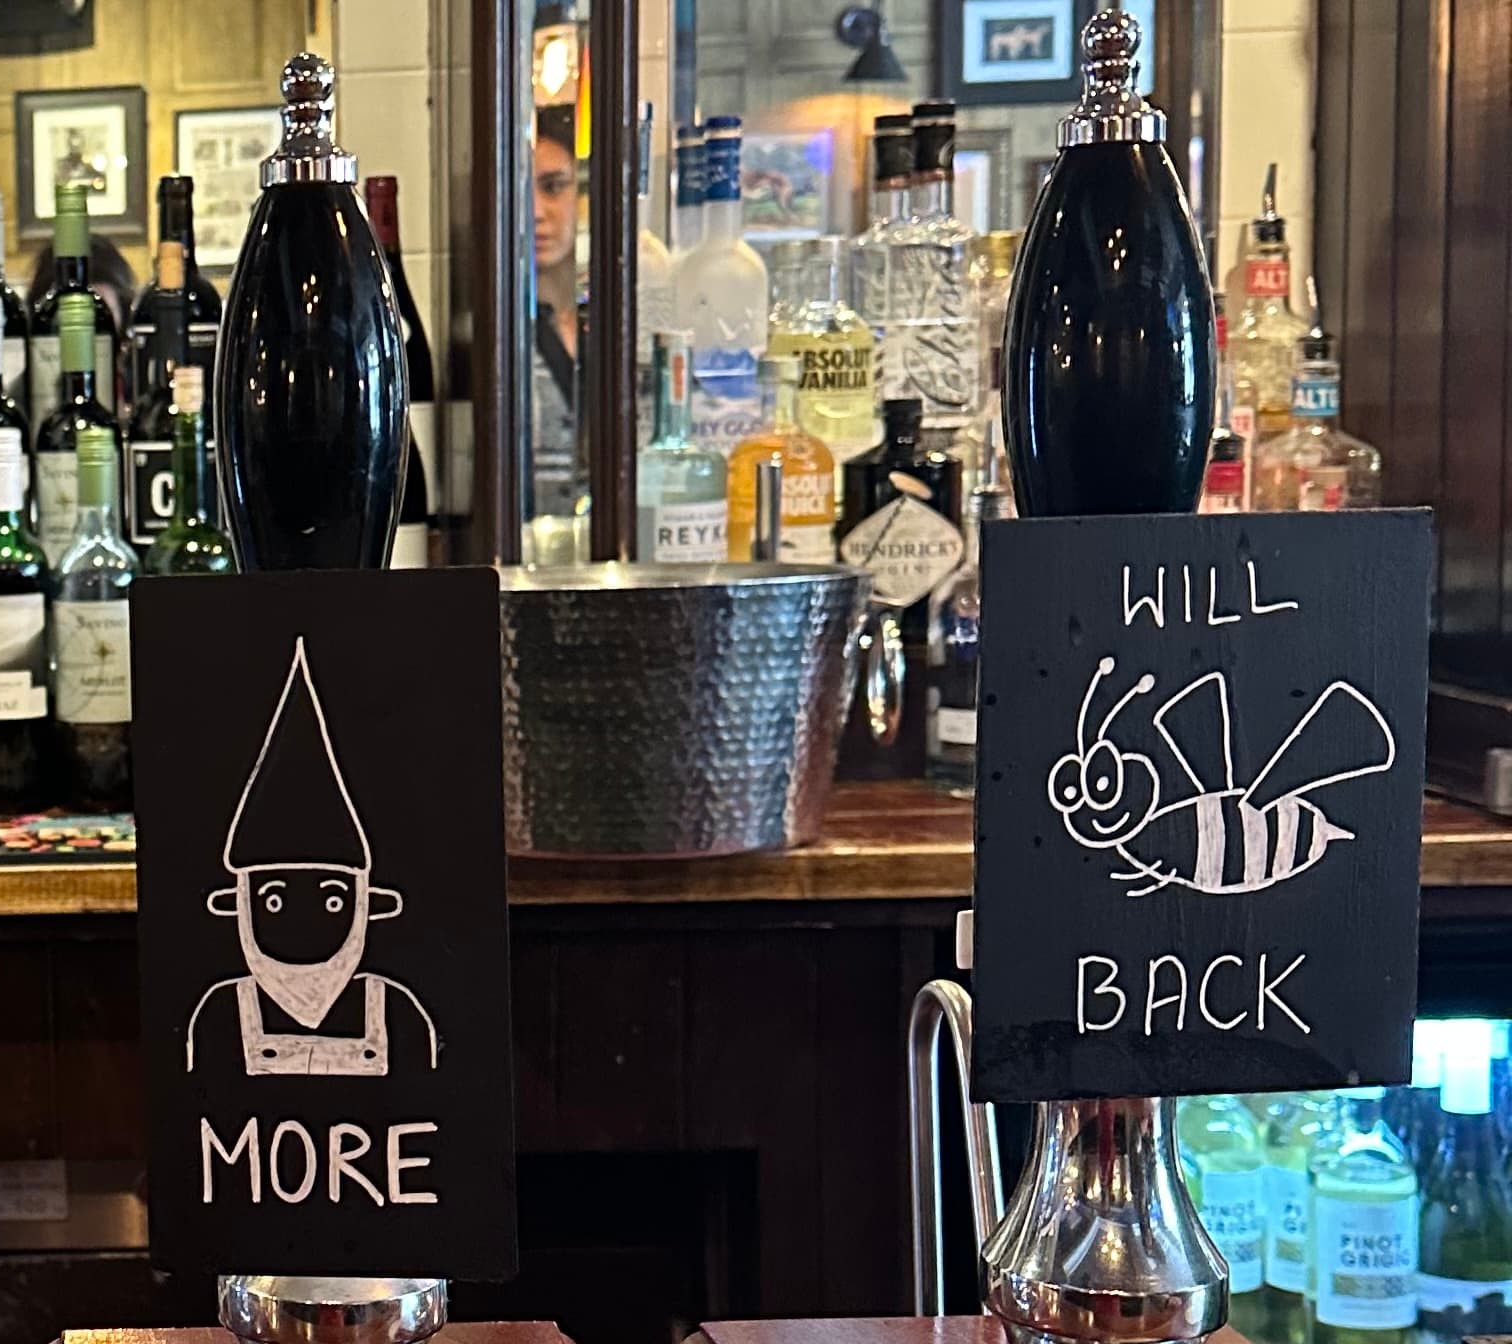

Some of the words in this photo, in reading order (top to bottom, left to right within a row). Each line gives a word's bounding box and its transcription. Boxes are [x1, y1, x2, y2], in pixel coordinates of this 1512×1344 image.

[1123, 561, 1299, 628] WILL
[1078, 954, 1311, 1036] BACK
[200, 1116, 439, 1207] MORE
[1340, 1233, 1403, 1251] PINOT
